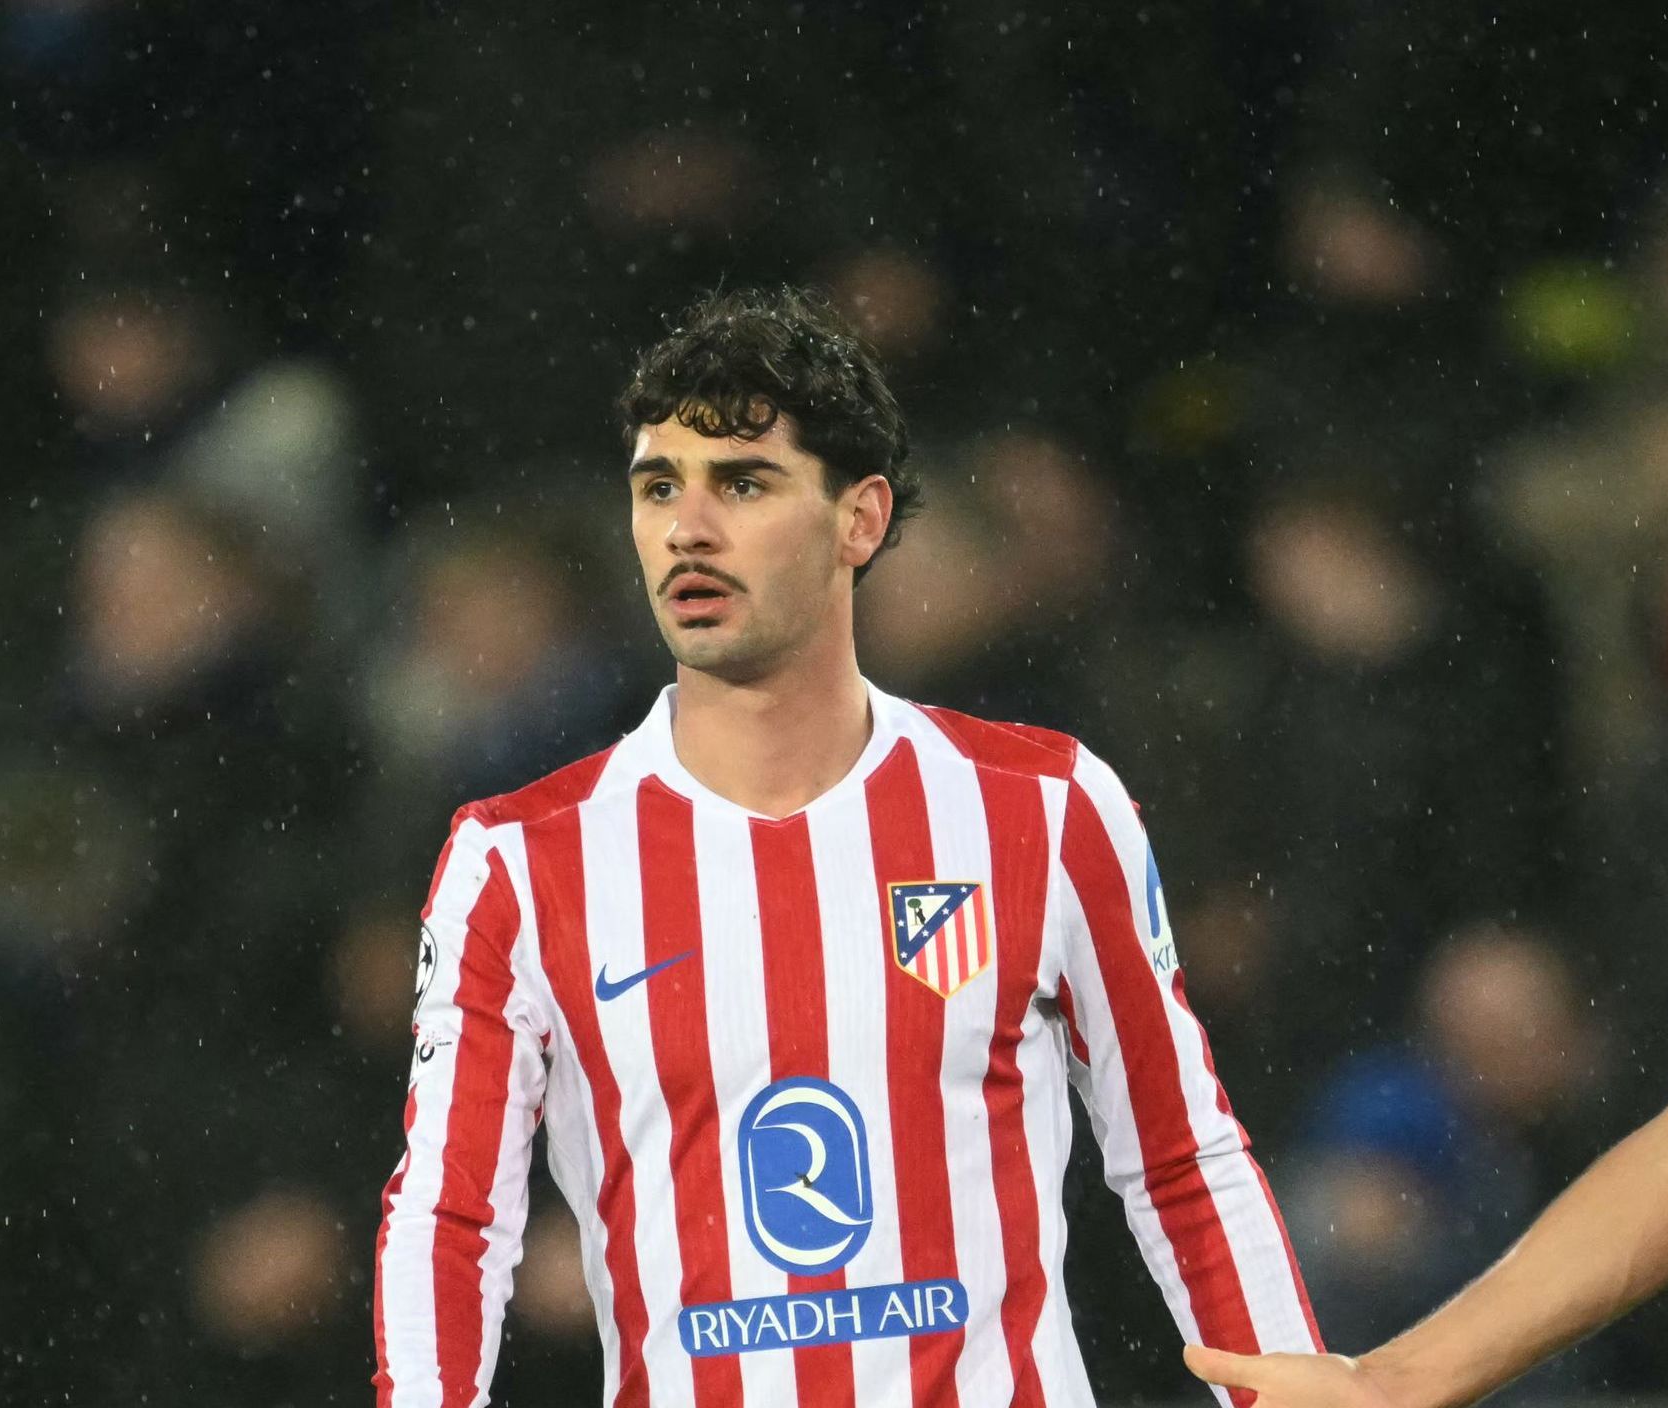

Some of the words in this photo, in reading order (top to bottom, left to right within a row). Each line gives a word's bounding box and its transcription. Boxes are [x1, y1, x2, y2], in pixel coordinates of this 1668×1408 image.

[1153, 943, 1179, 974] kr
[689, 1295, 862, 1350] RIYADH
[879, 1286, 960, 1331] AIR
